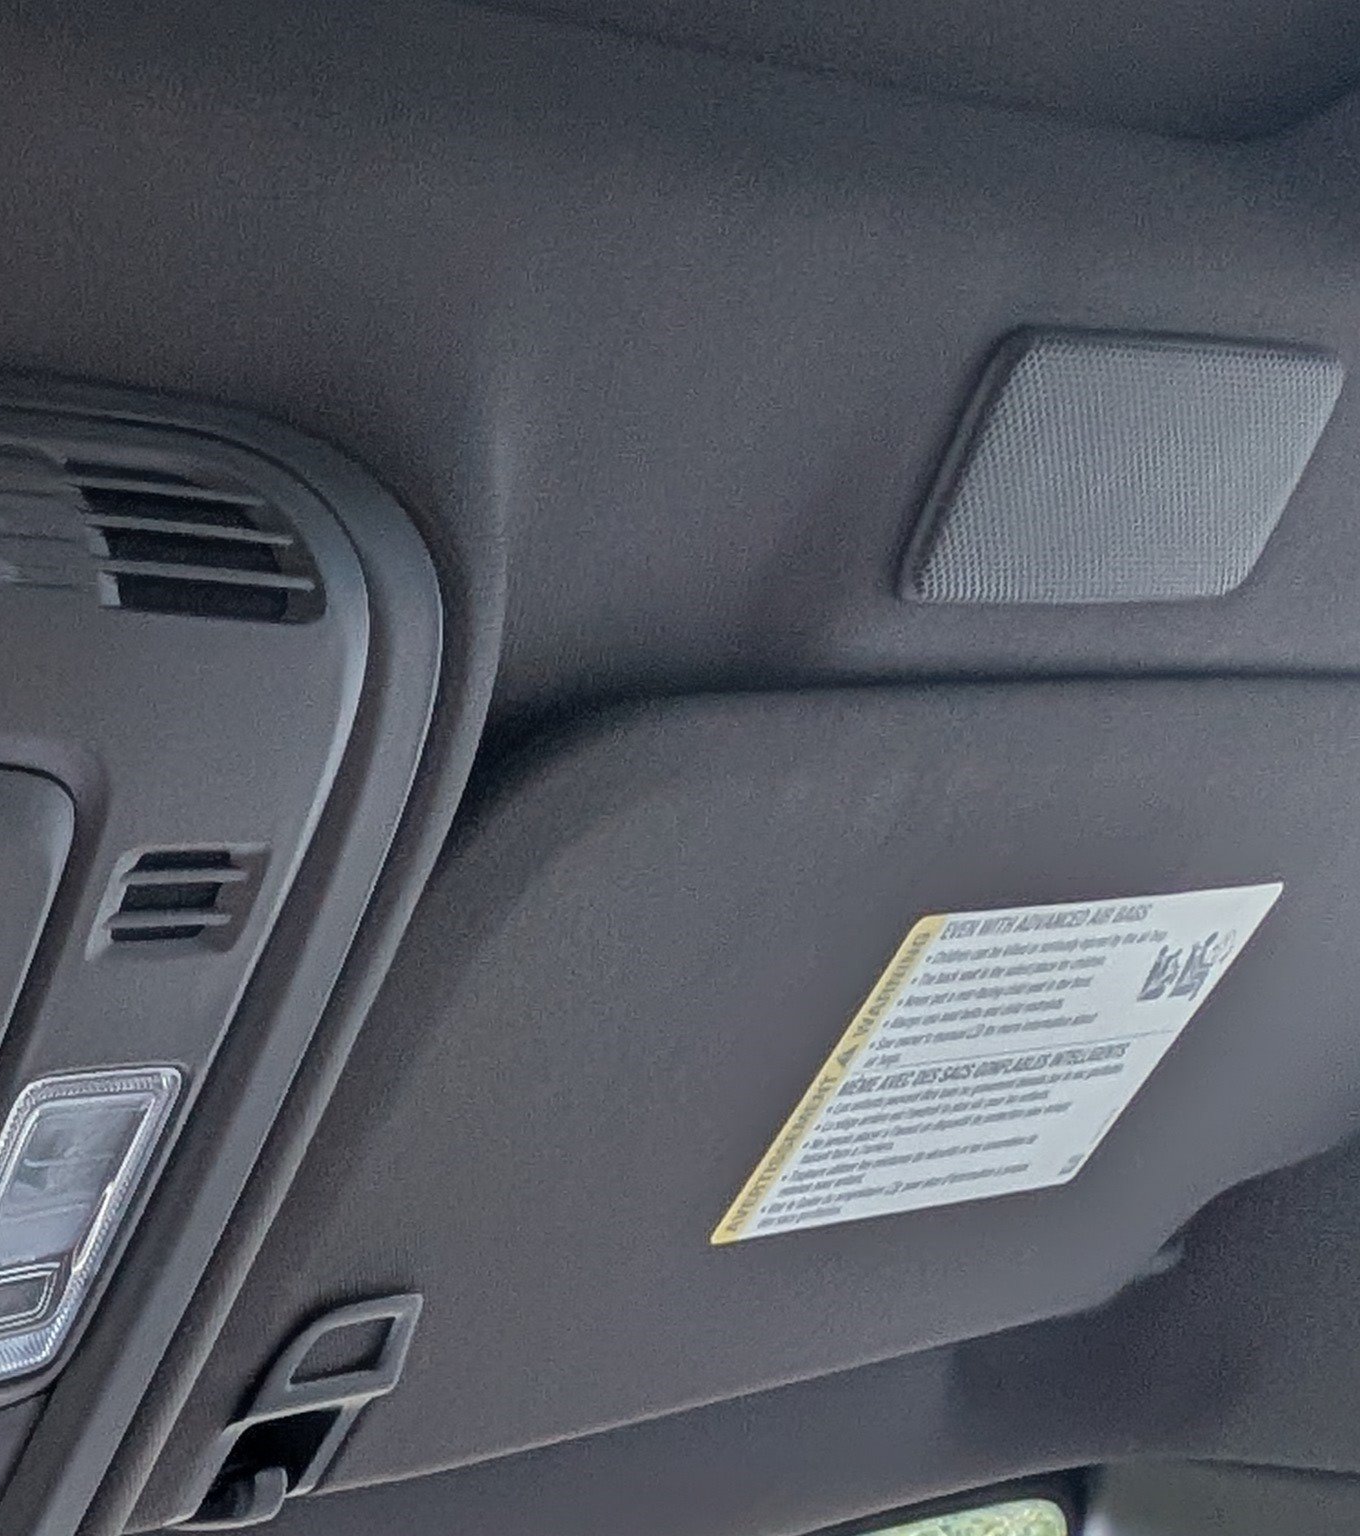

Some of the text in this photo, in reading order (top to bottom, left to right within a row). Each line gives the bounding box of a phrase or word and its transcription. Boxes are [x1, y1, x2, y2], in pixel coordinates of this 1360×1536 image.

[940, 919, 980, 940] EVEN
[978, 916, 1018, 935] WITH
[1014, 909, 1090, 932] ADVANCED
[1086, 907, 1115, 925] AIR
[853, 933, 929, 1037] WARNING
[876, 1070, 915, 1091] AVEC
